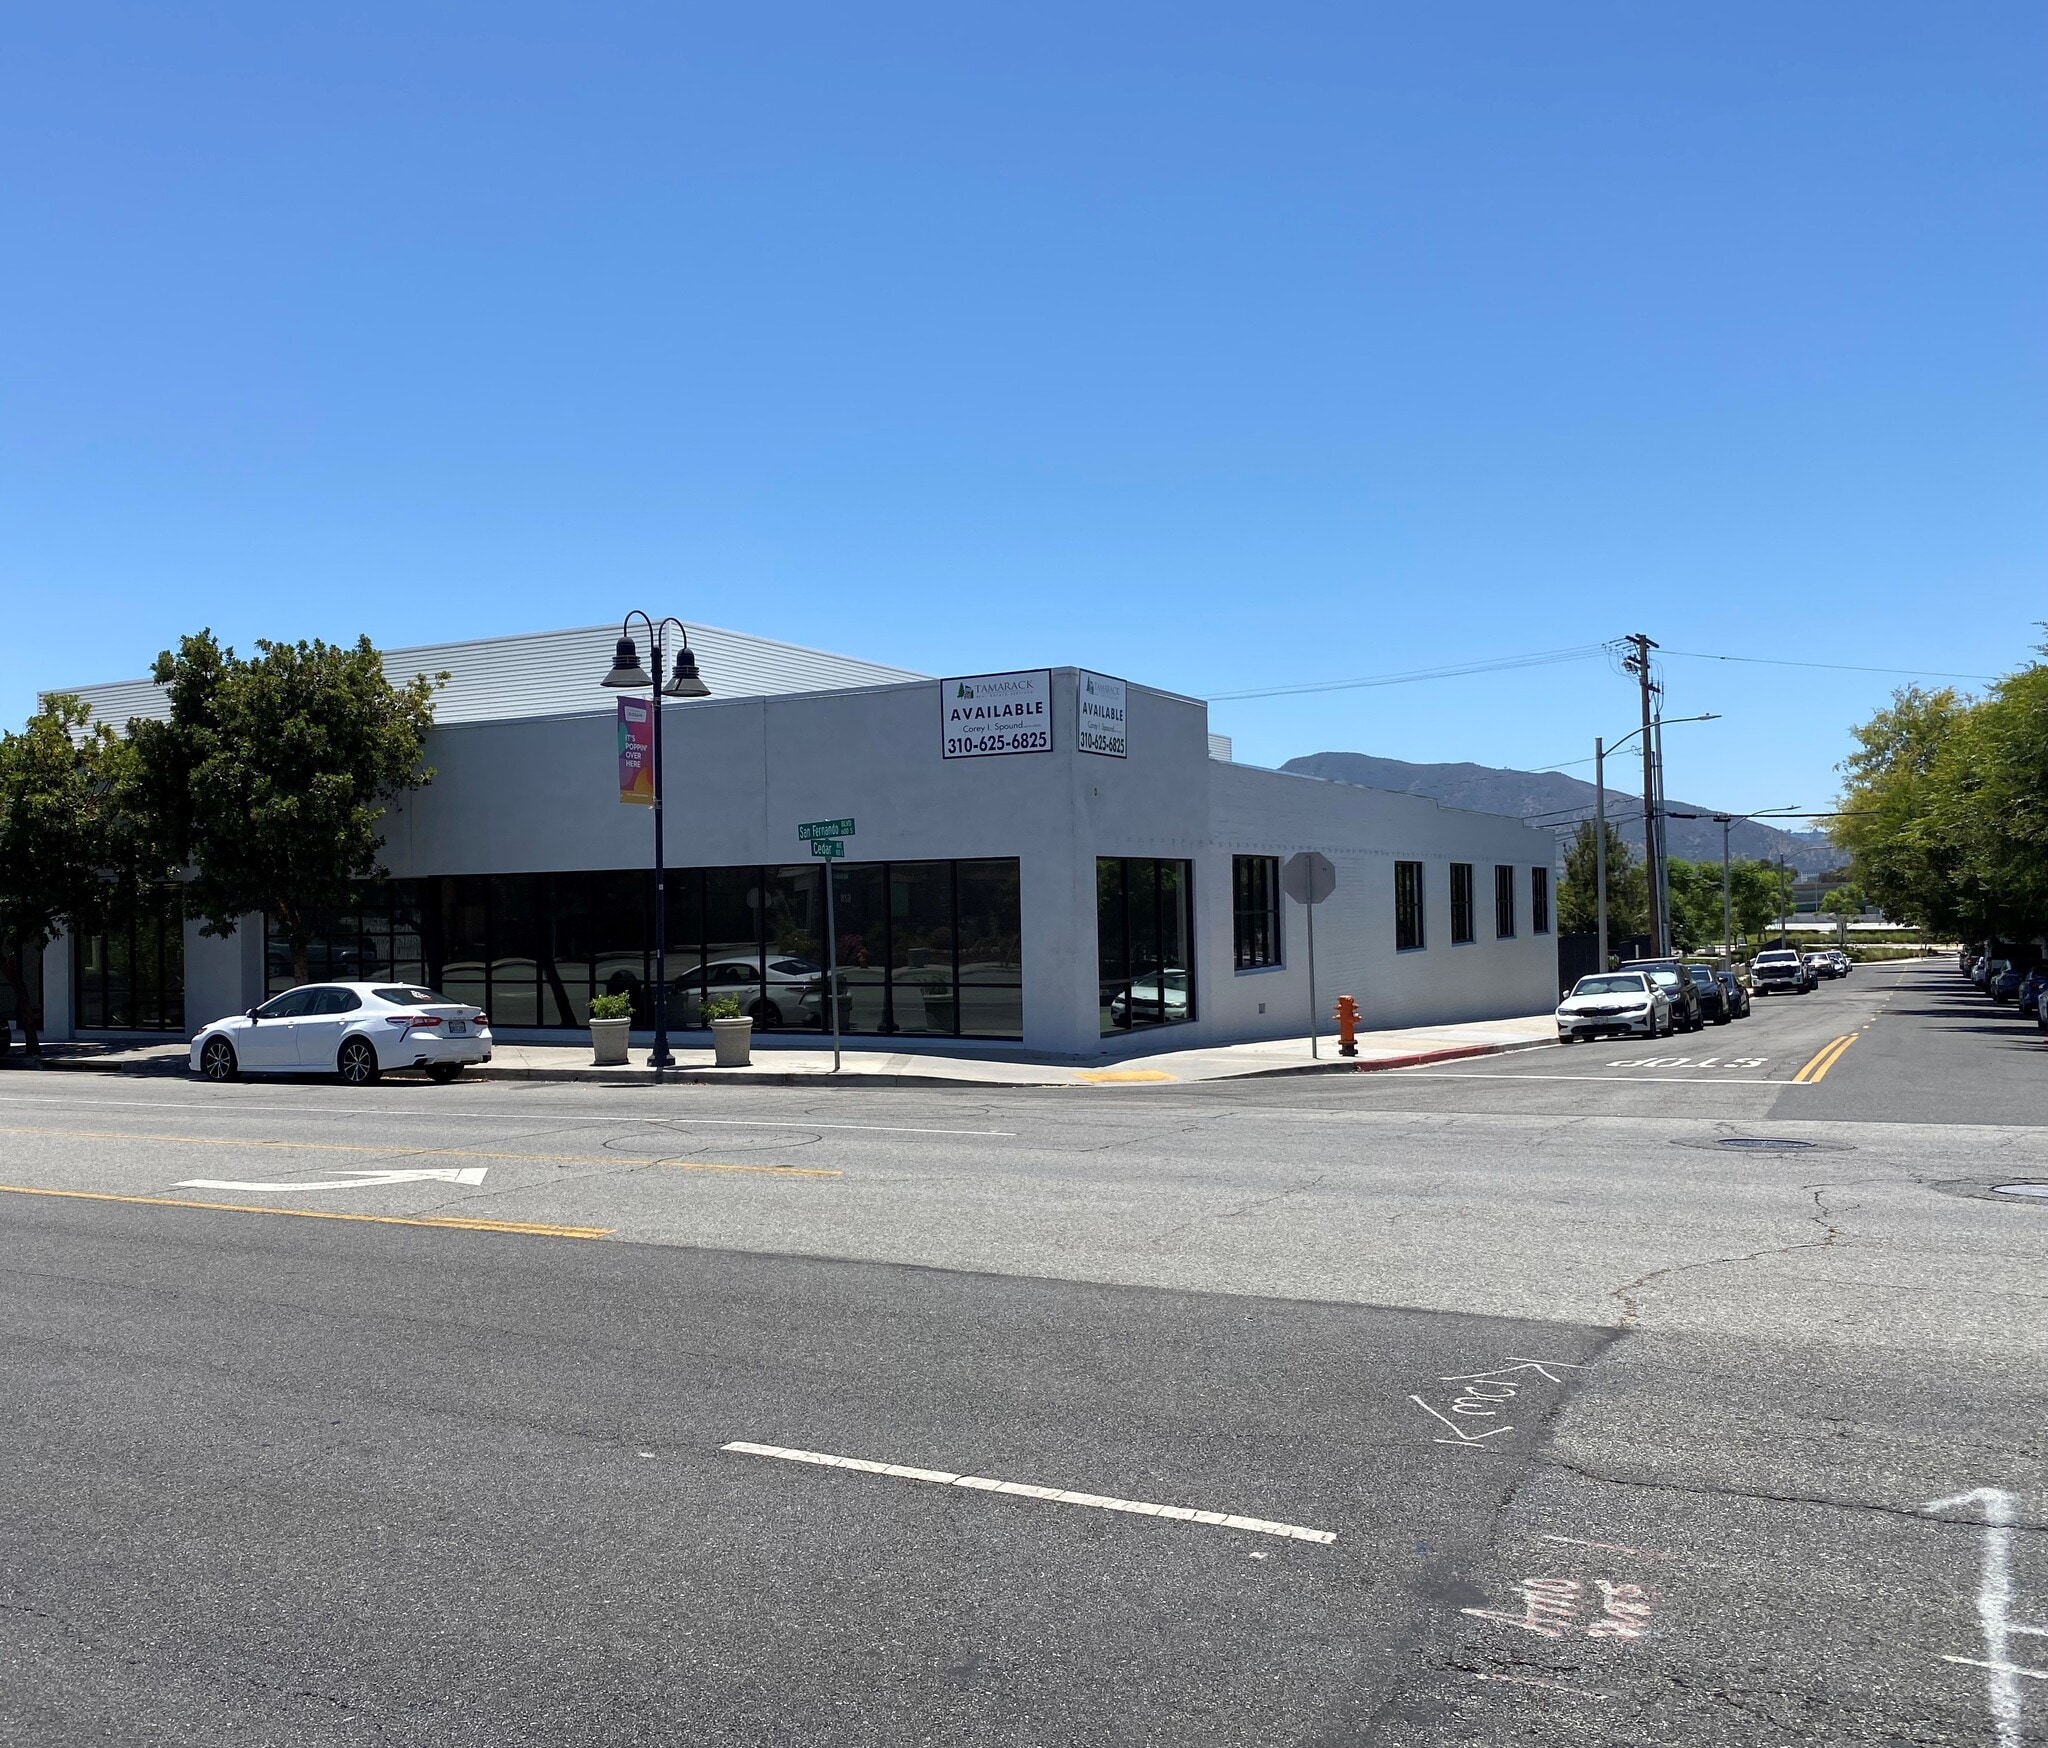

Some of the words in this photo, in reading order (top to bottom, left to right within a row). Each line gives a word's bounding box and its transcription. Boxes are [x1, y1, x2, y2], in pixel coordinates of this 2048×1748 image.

[975, 680, 1034, 694] TAMARACK
[951, 701, 1043, 721] AVAILABLE
[1082, 702, 1124, 722] AVAILABLE
[963, 724, 985, 734] Corey
[994, 720, 1023, 733] Spound
[625, 734, 636, 742] IT'S
[947, 731, 1047, 754] 310-625-6825
[1080, 731, 1125, 754] 310-625-6825
[625, 742, 648, 752] POPPIN'
[625, 751, 641, 760] OVER
[625, 760, 641, 768] HERE
[840, 819, 852, 828] BLVD
[799, 826, 811, 839] San
[812, 823, 839, 838] Fernando
[813, 841, 832, 855] Cedar
[1605, 1057, 1769, 1068] STOP
